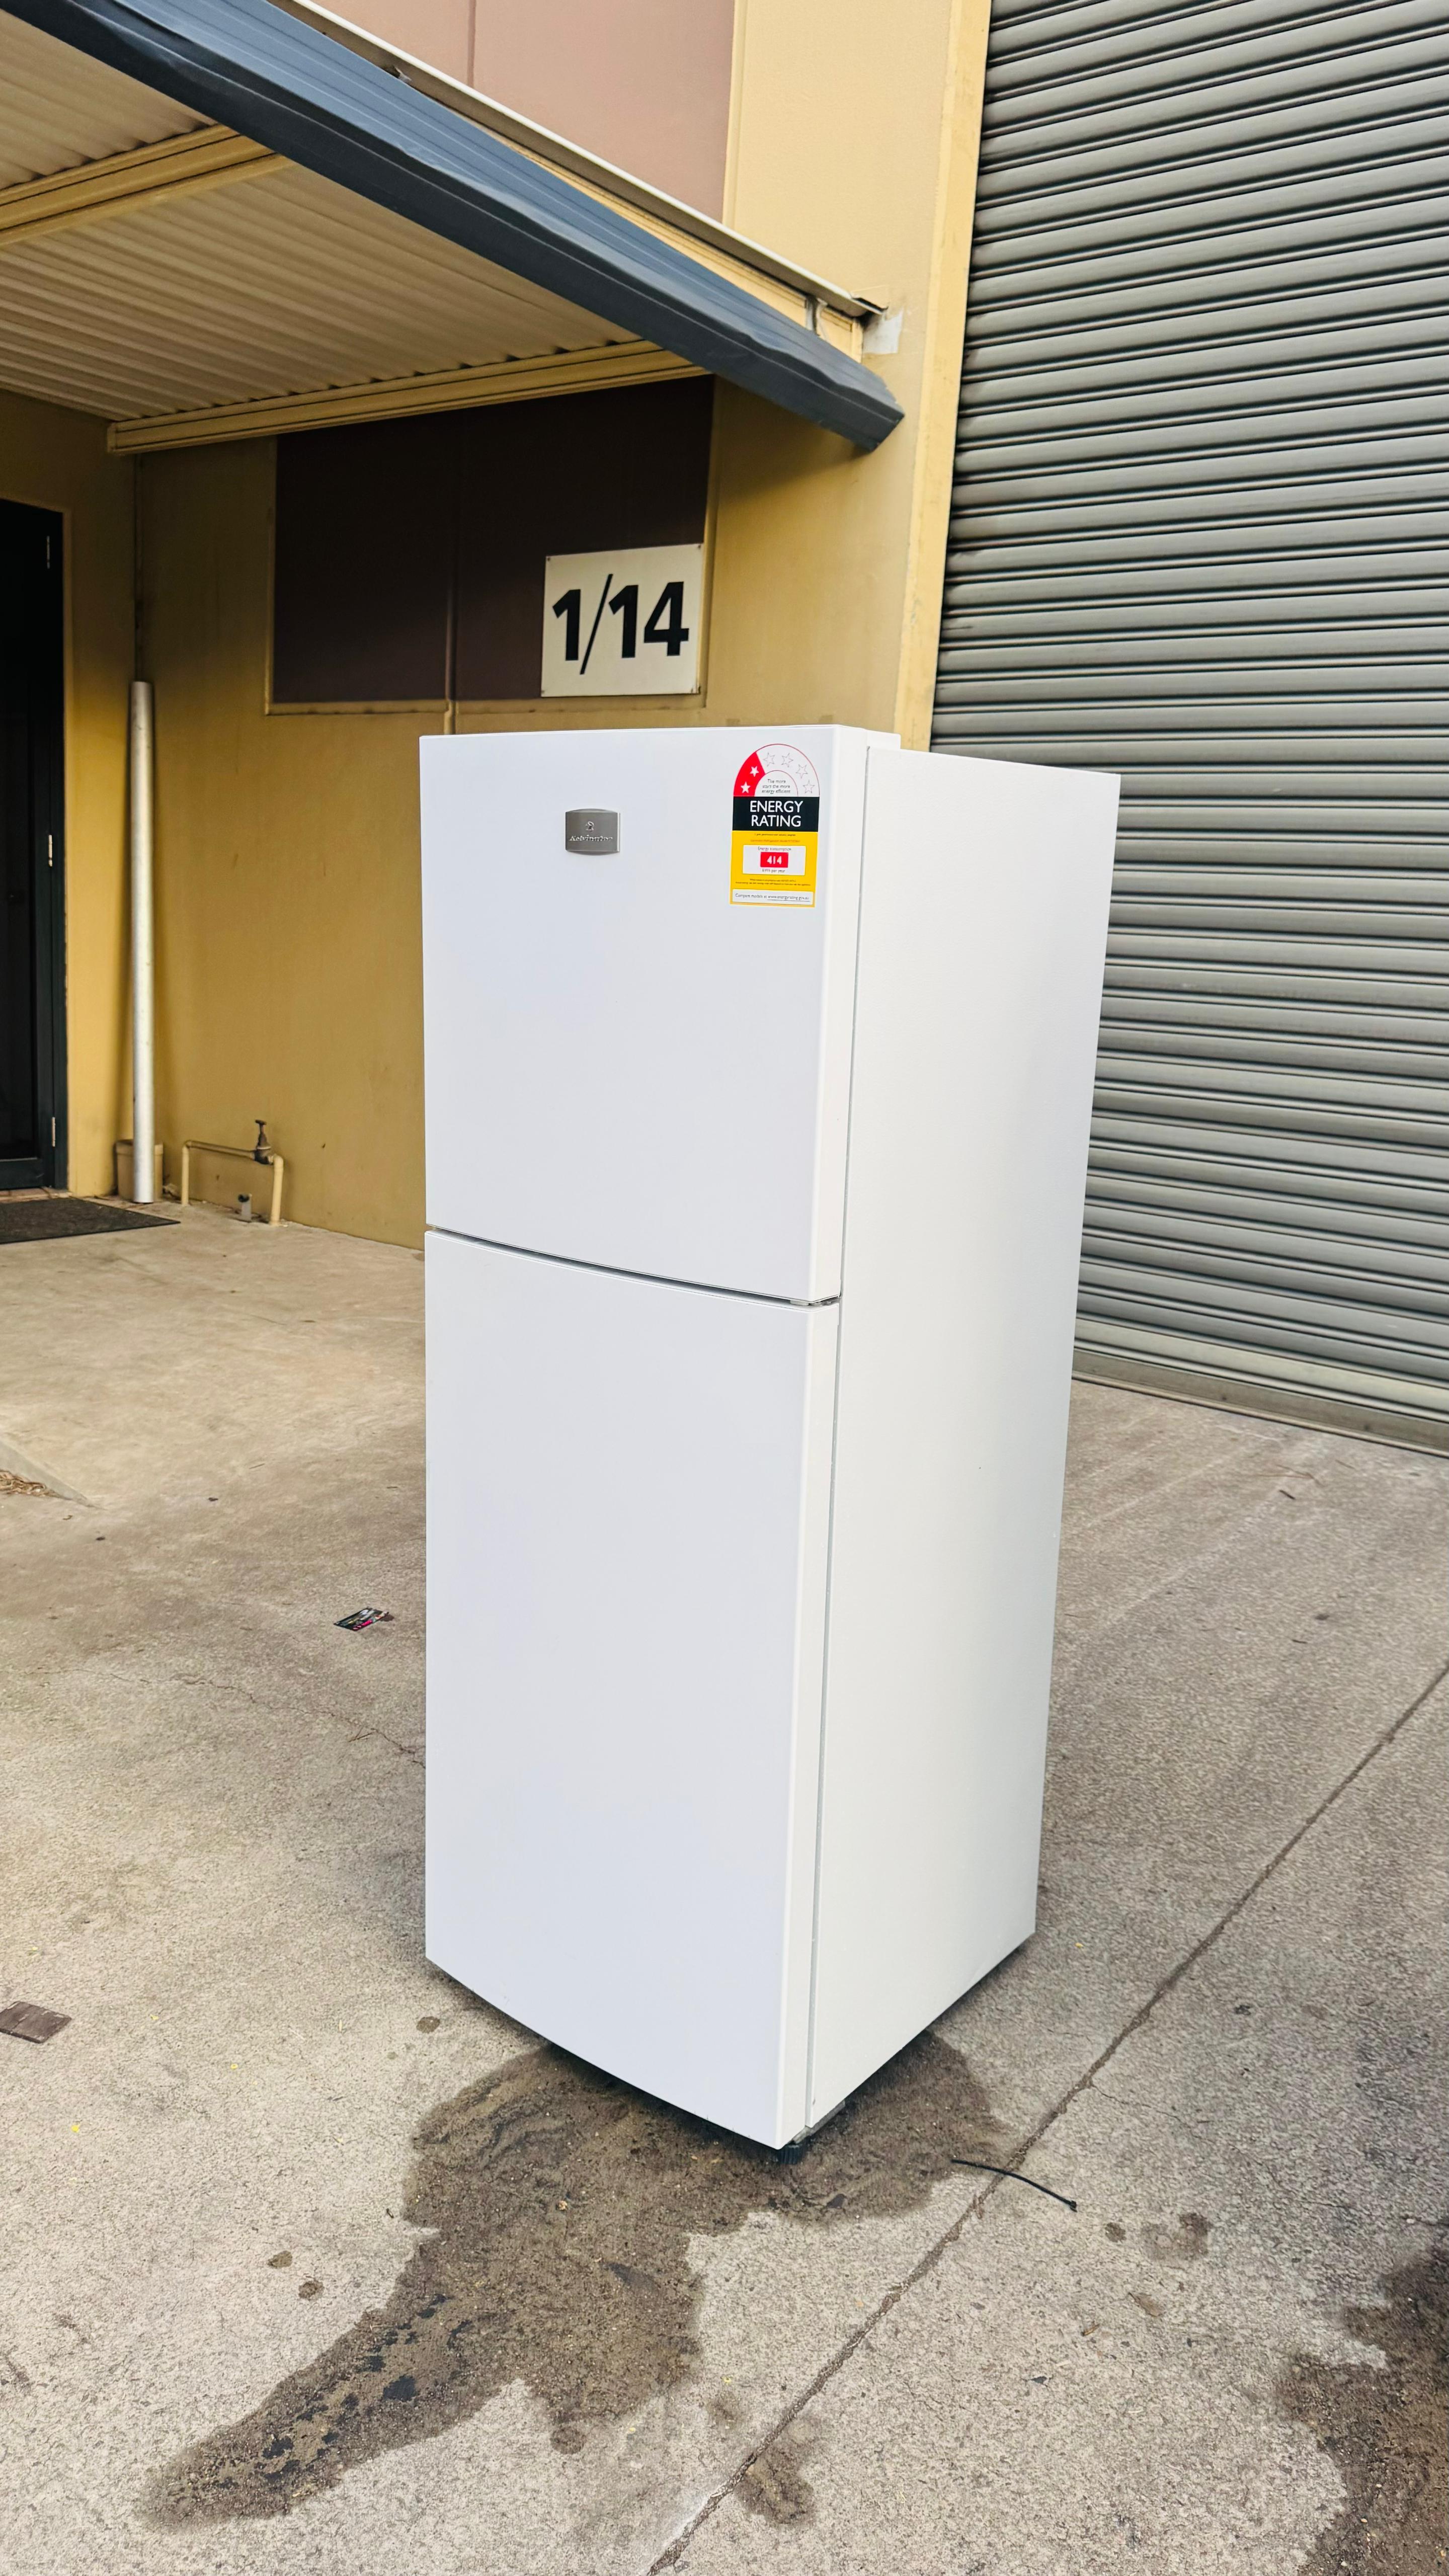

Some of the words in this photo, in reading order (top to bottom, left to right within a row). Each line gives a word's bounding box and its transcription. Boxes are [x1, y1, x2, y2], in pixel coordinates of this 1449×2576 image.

[552, 573, 689, 675] 1/14
[750, 800, 803, 813] ENERGY
[751, 815, 801, 827] RATING
[767, 855, 782, 864] 414
